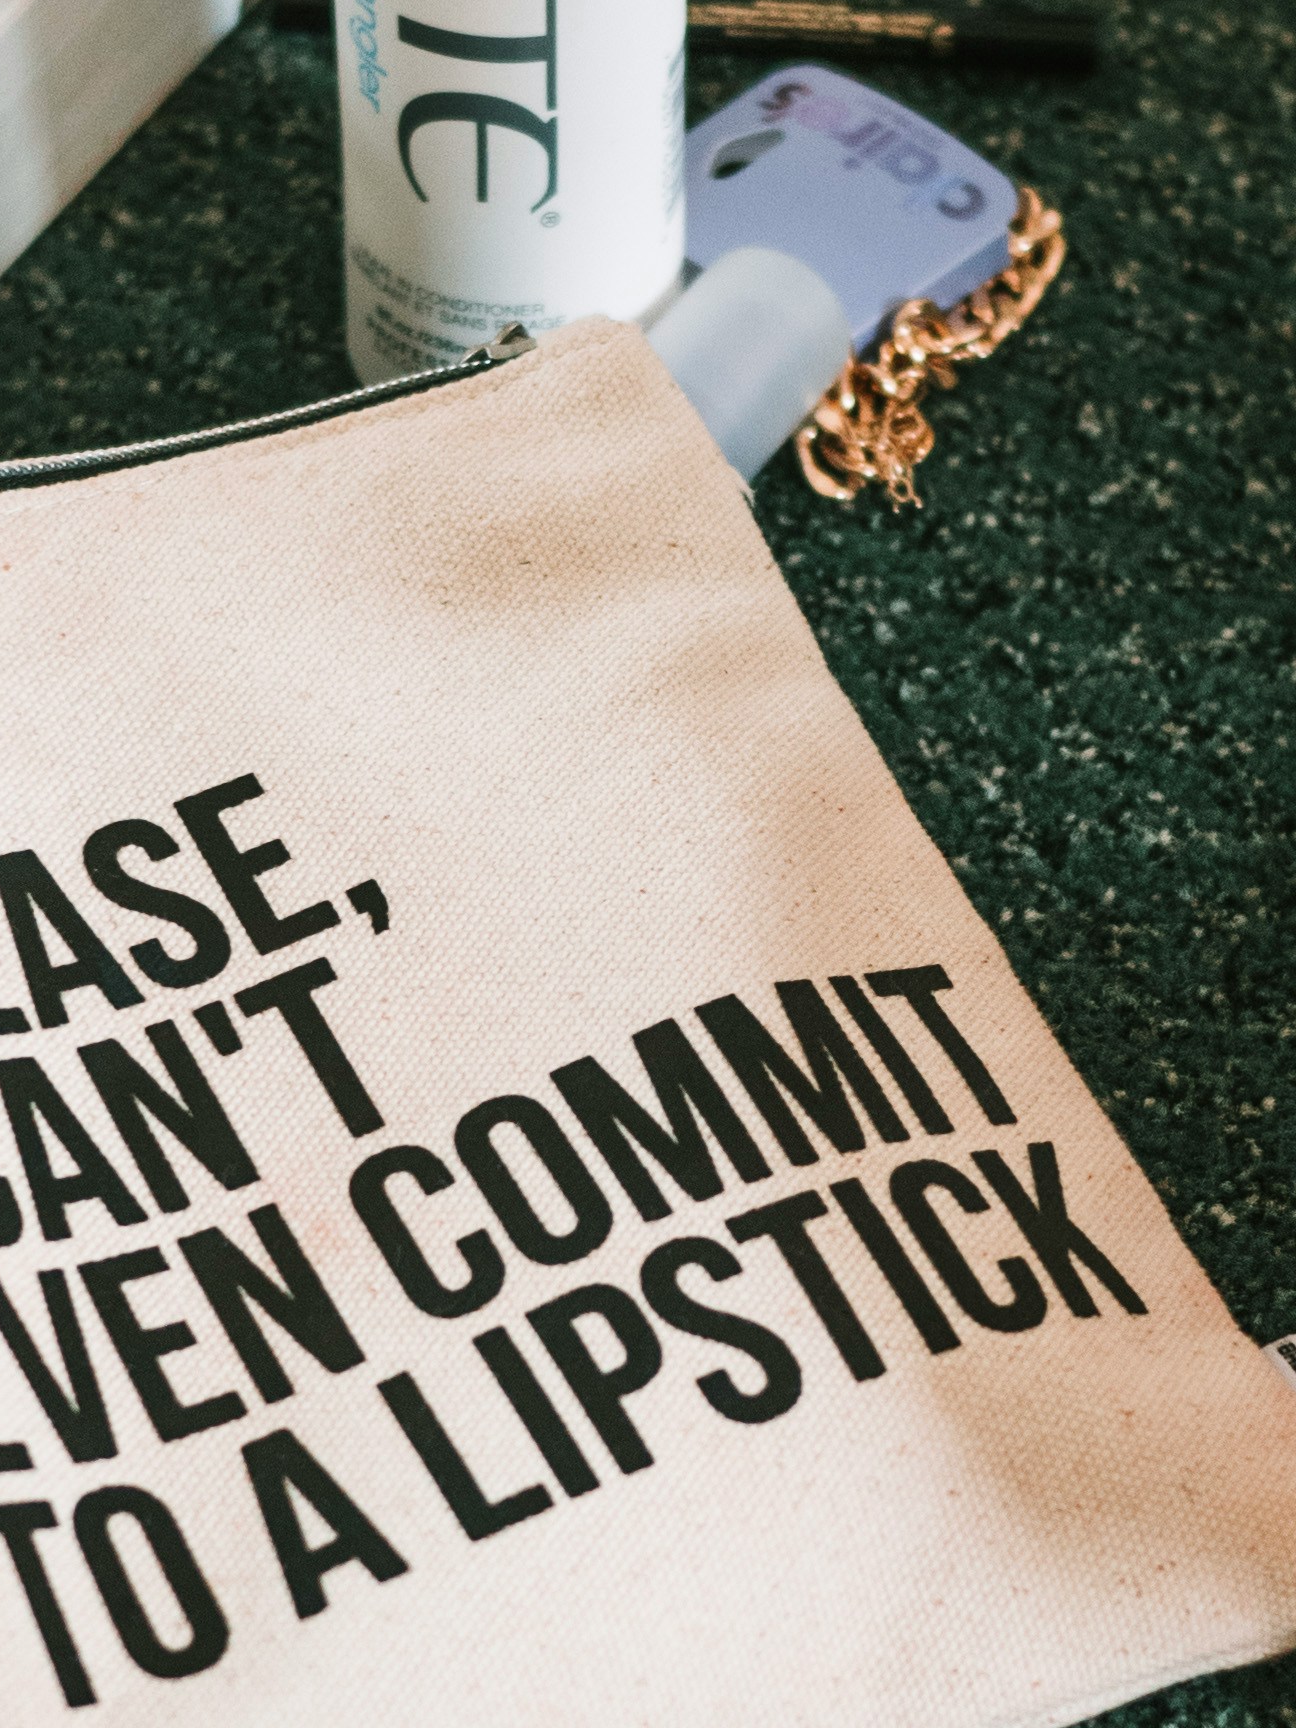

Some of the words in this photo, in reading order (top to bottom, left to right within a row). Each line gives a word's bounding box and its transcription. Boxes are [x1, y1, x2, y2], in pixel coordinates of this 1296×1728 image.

[349, 963, 1019, 1319] COMMIT
[241, 1428, 410, 1622] A
[376, 1141, 1148, 1541] LIPSTICK
